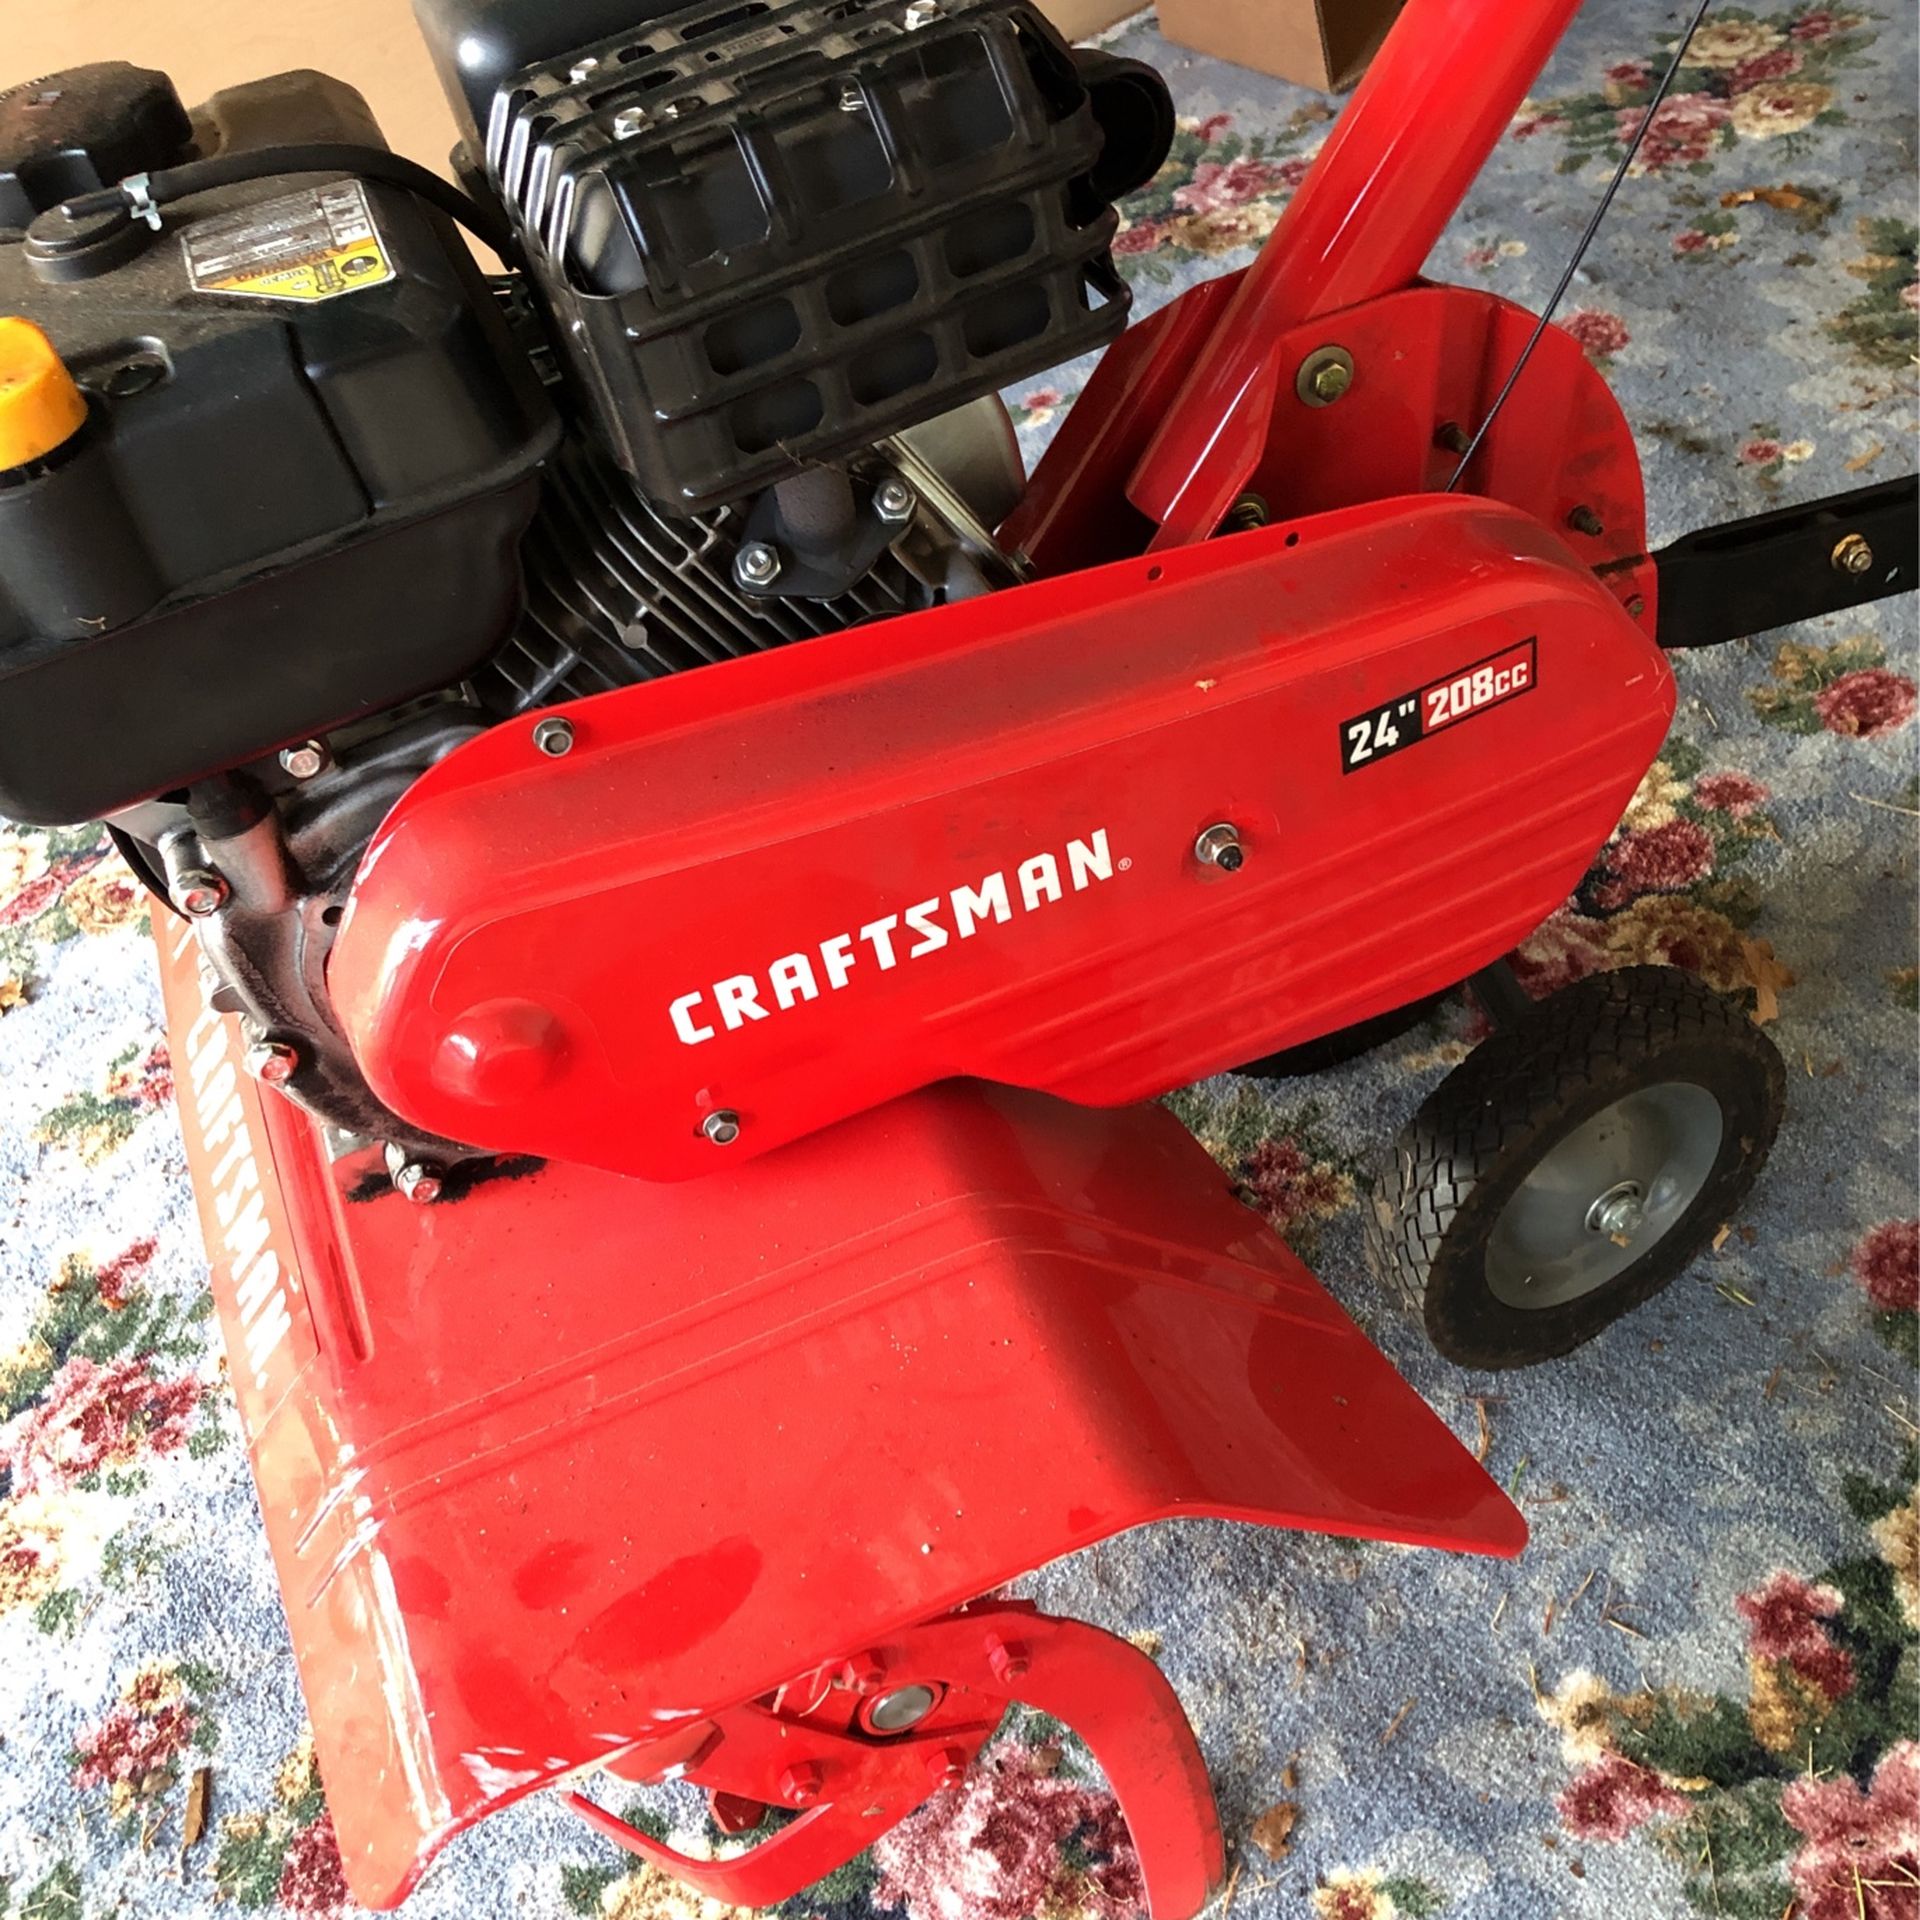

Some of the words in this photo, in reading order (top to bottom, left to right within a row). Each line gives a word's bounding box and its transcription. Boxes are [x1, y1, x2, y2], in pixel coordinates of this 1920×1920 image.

[1348, 699, 1416, 764] 24"
[669, 828, 1114, 1045] CRAFTSMAN
[186, 1007, 291, 1373] CRAFTSMAN
